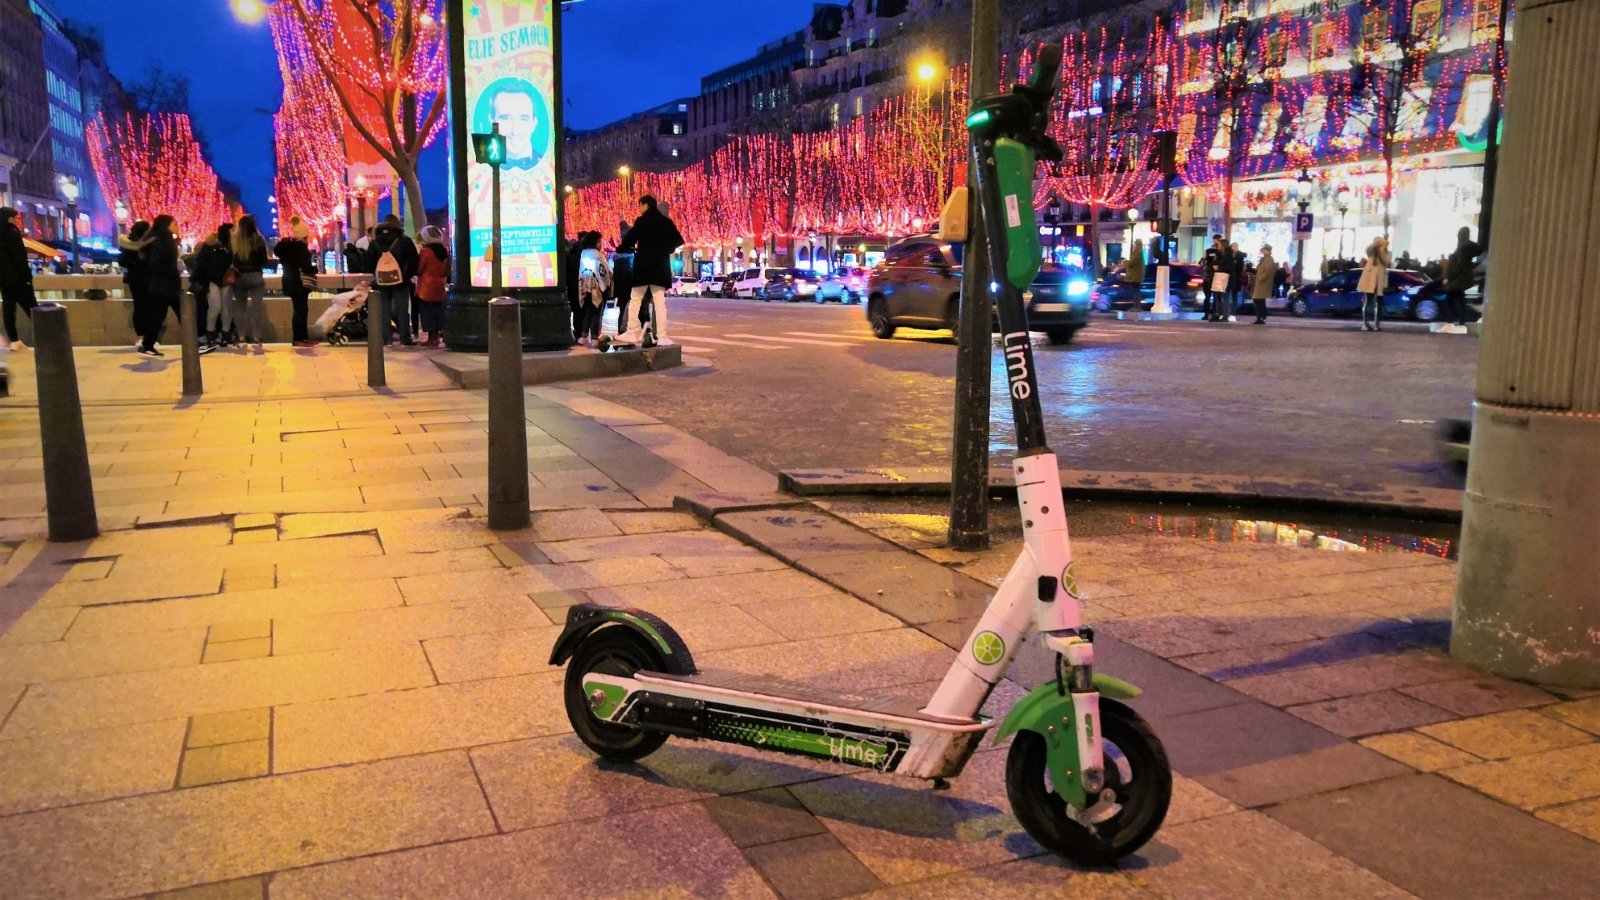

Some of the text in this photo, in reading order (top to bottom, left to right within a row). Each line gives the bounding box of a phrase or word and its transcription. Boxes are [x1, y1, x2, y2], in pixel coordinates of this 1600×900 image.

[468, 25, 549, 60] ELIE SEMOUN
[1301, 216, 1309, 229] P
[1004, 331, 1031, 399] Lime
